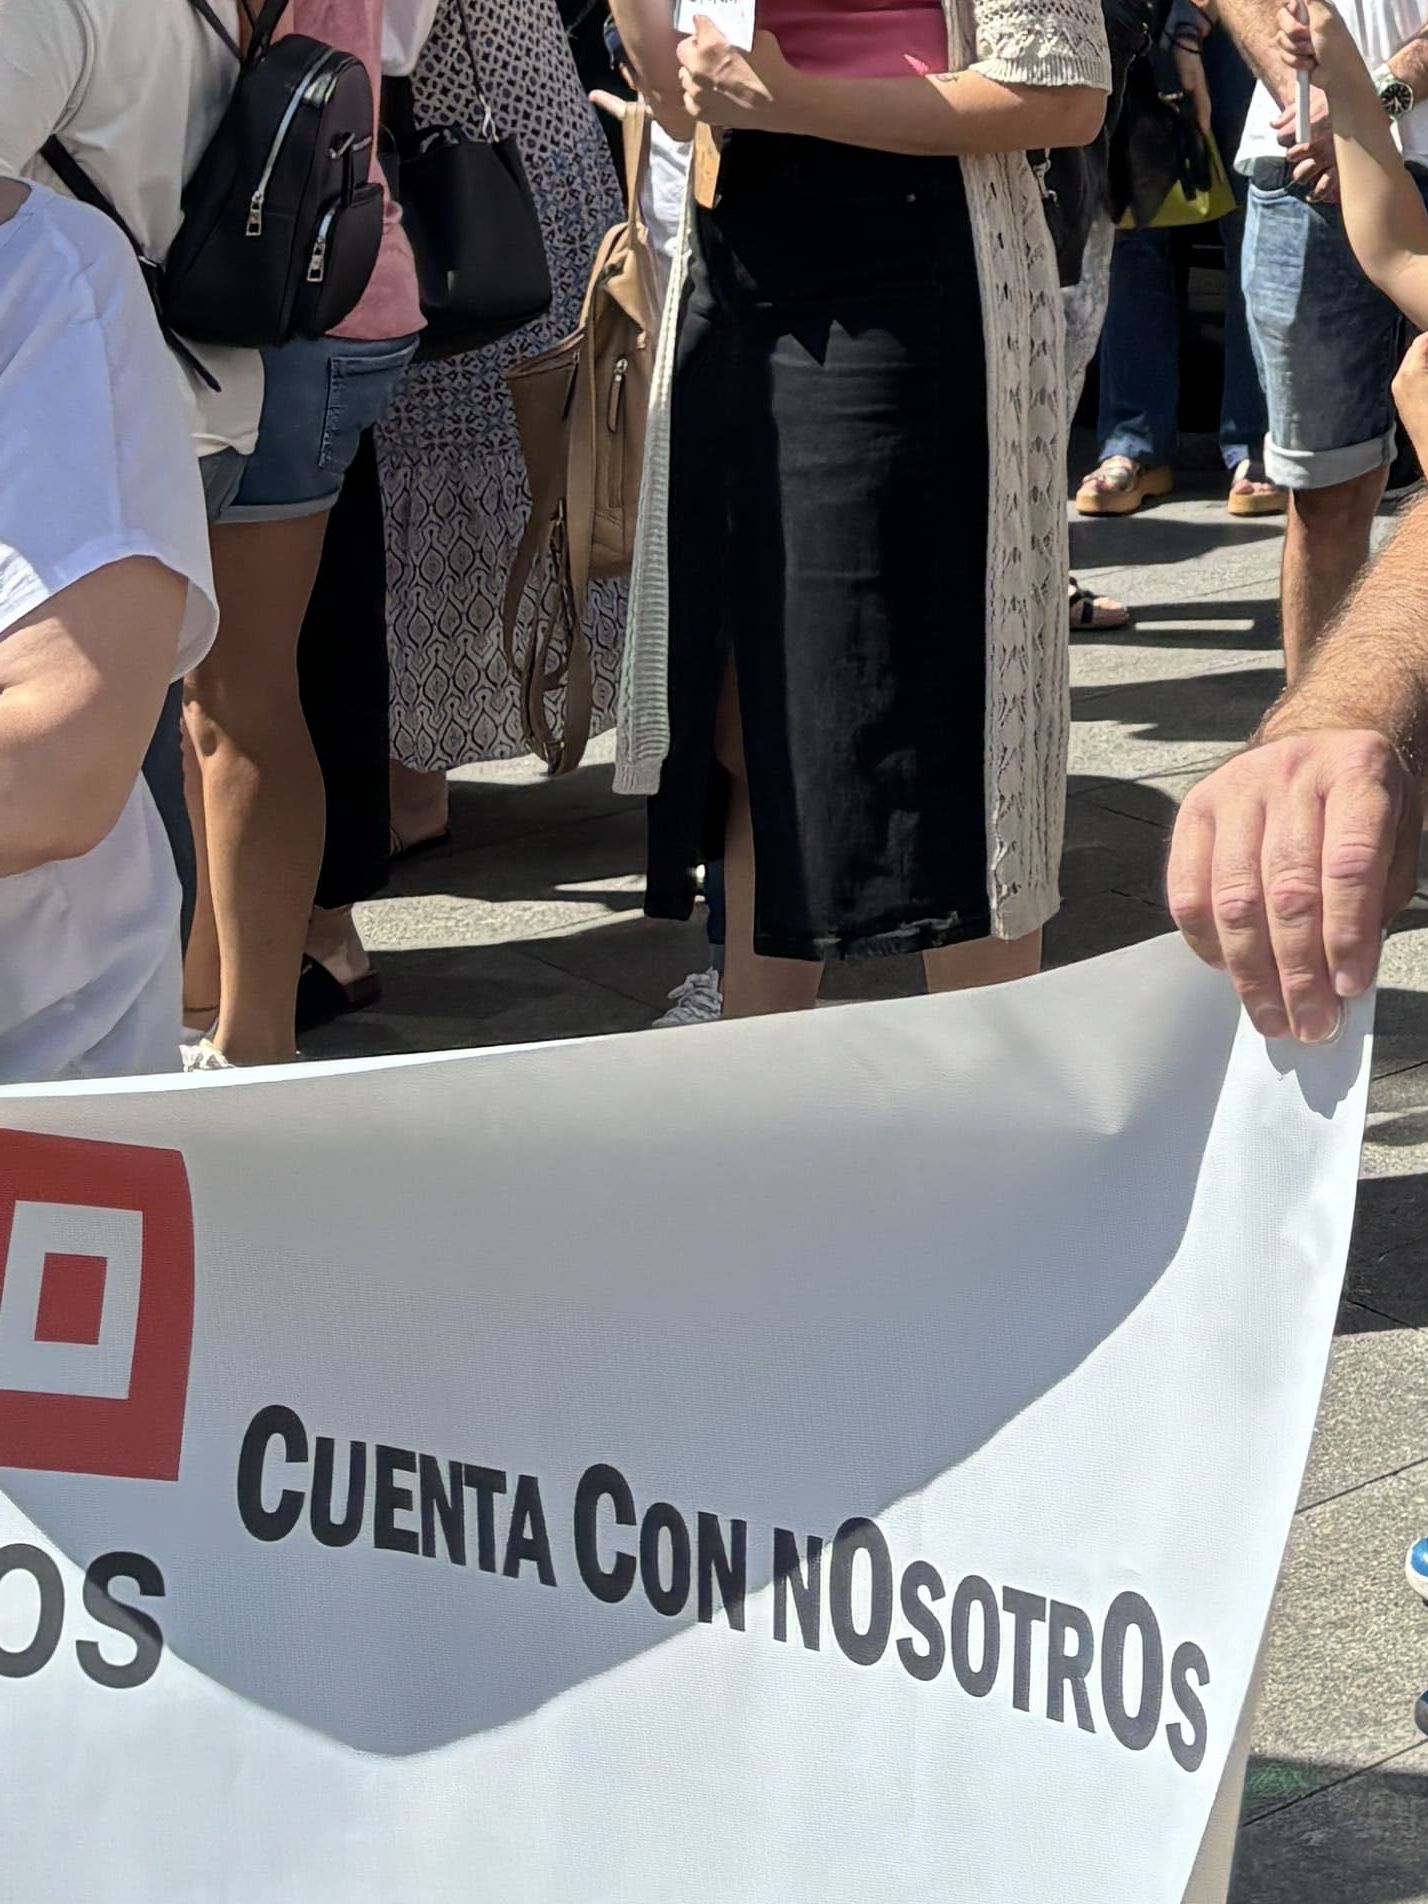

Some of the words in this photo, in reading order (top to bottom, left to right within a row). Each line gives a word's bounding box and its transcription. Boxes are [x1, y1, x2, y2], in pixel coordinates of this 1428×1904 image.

[236, 1403, 558, 1588] CUENTA
[572, 1462, 748, 1632] CON
[772, 1517, 1212, 1774] NOSOTROS
